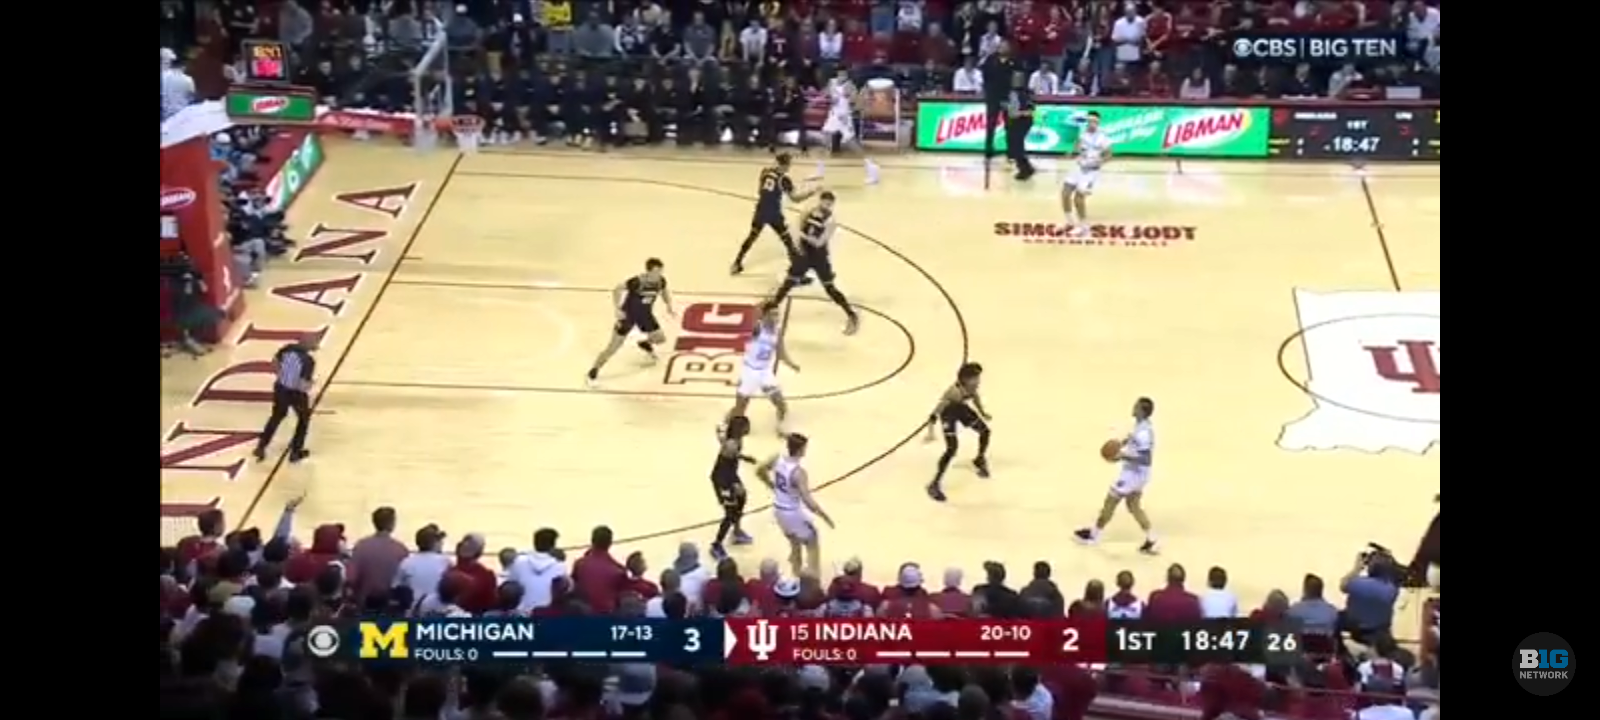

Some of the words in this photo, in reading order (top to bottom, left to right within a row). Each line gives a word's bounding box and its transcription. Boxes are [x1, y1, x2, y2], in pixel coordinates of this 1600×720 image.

[936, 111, 1005, 144] LIBM
[1162, 113, 1244, 149] LIBMAN
[1333, 136, 1380, 151] 18:47
[1091, 225, 1197, 240] SKJODT
